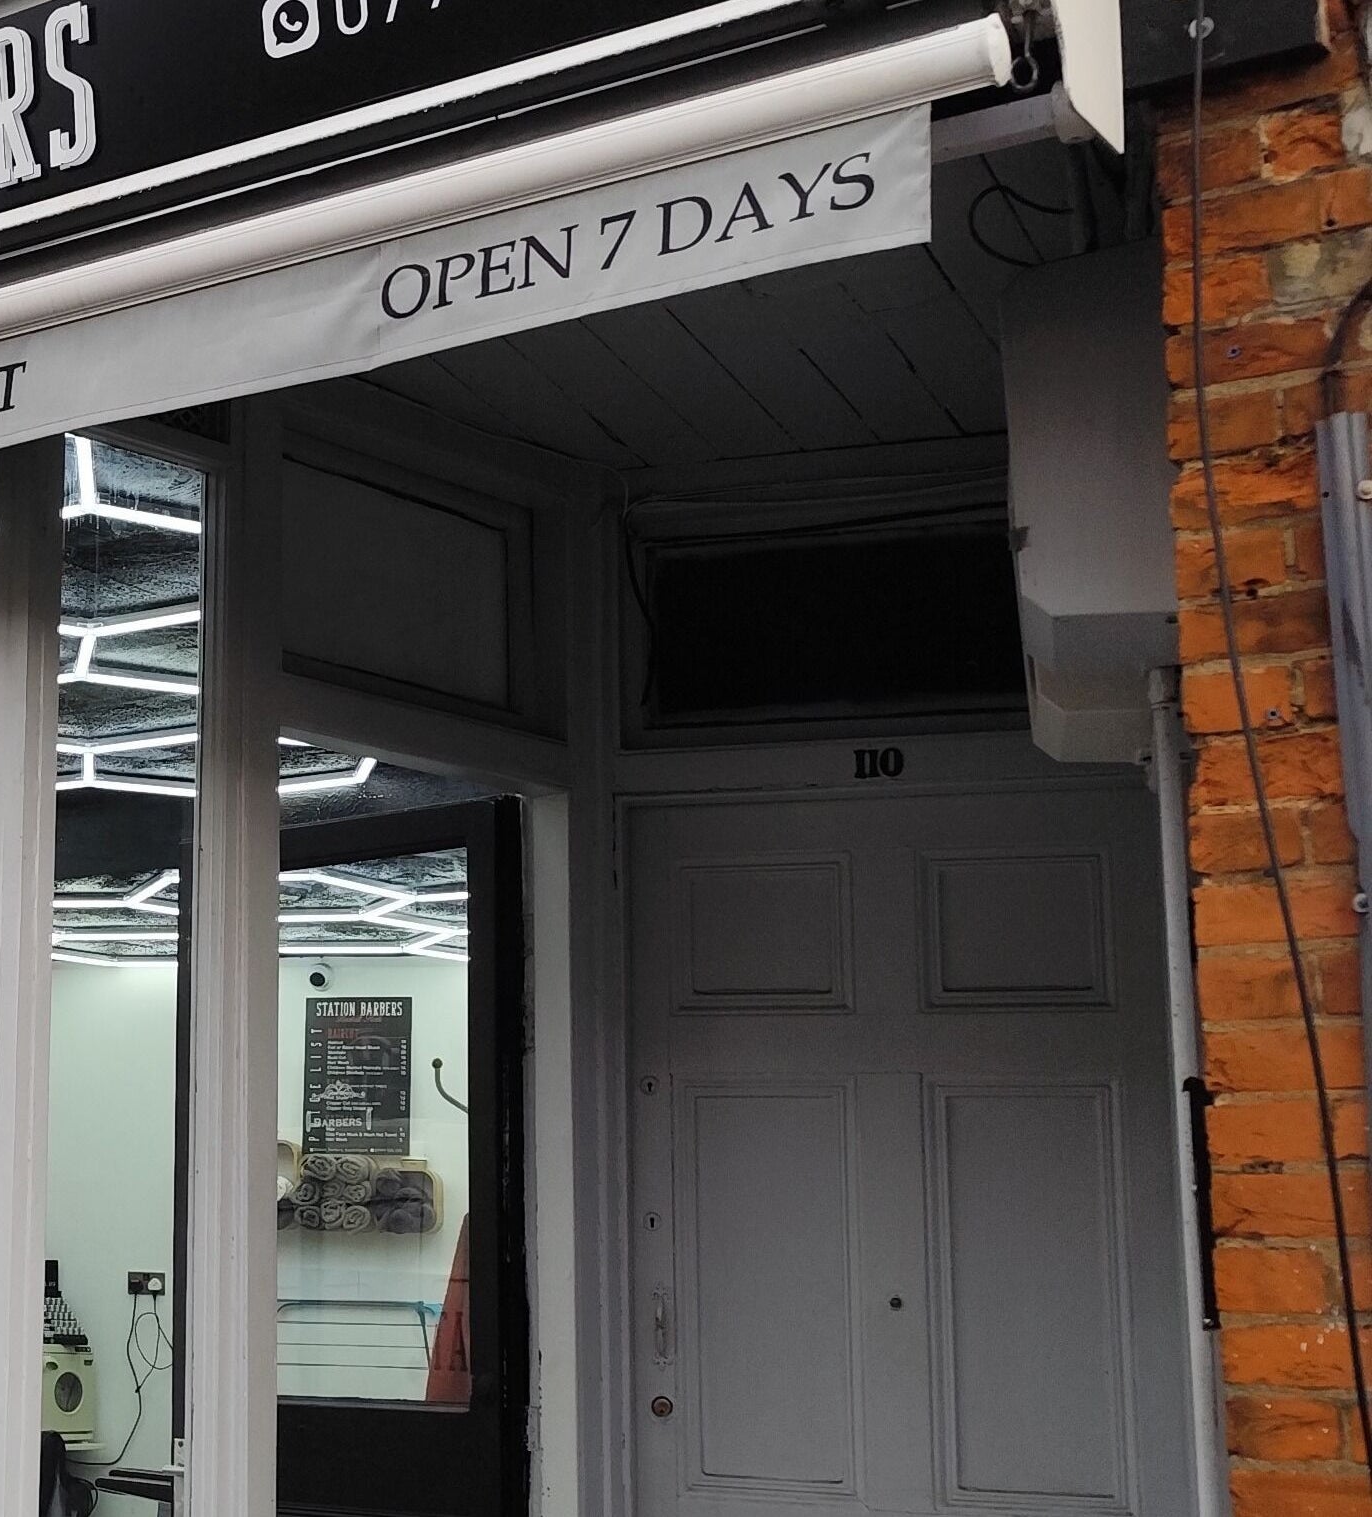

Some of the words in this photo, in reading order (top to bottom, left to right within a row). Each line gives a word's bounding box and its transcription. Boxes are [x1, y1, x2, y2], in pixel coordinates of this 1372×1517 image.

[381, 226, 578, 320] OPEN
[599, 210, 636, 271] 7
[656, 152, 876, 256] DAYS
[853, 747, 904, 779] 110
[316, 1001, 355, 1017] STATION
[360, 1001, 403, 1017] BARBERS
[313, 1117, 363, 1129] BARBERS
